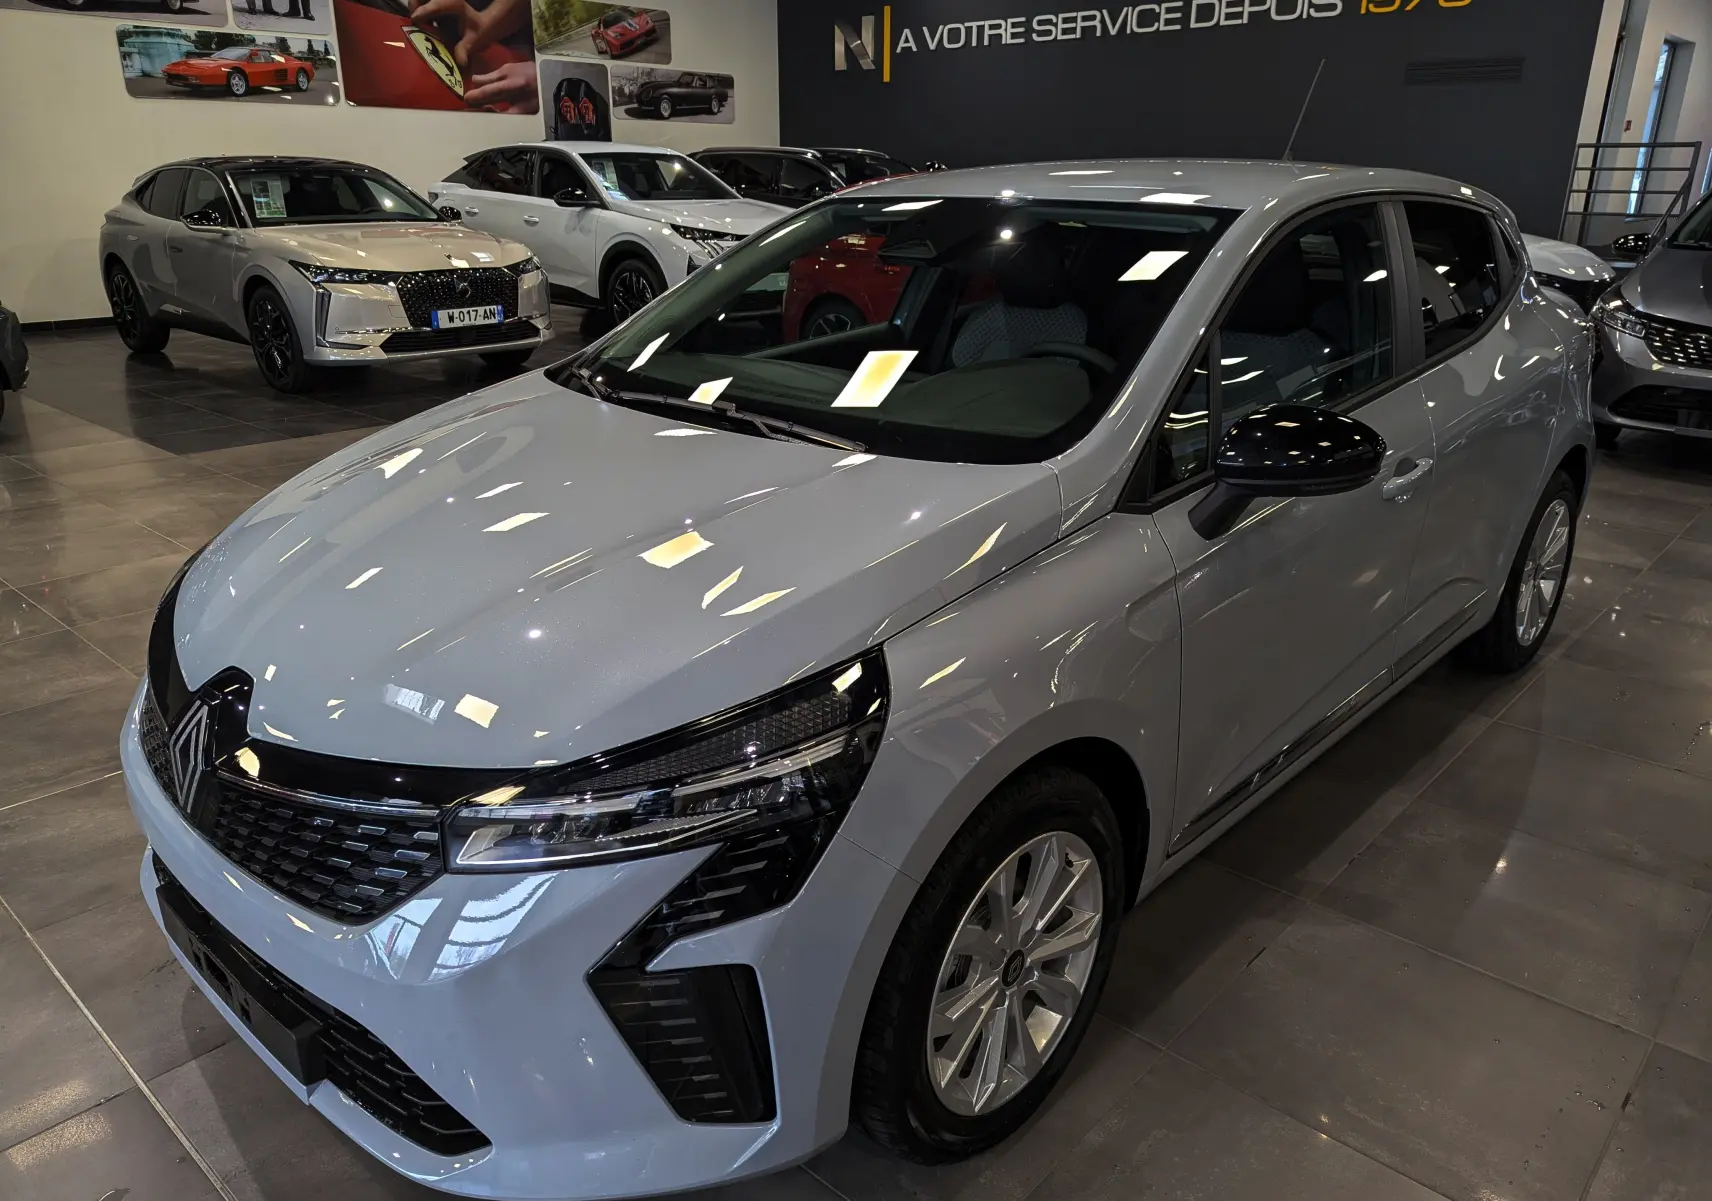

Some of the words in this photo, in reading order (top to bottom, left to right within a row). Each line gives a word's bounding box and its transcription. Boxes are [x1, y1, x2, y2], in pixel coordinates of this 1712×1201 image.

[896, 28, 917, 53] A
[922, 17, 1026, 51] VOTRE
[1031, 1, 1183, 42] SERVICE
[1190, 0, 1342, 28] DEPUIS
[447, 307, 496, 324] W-017-AN
